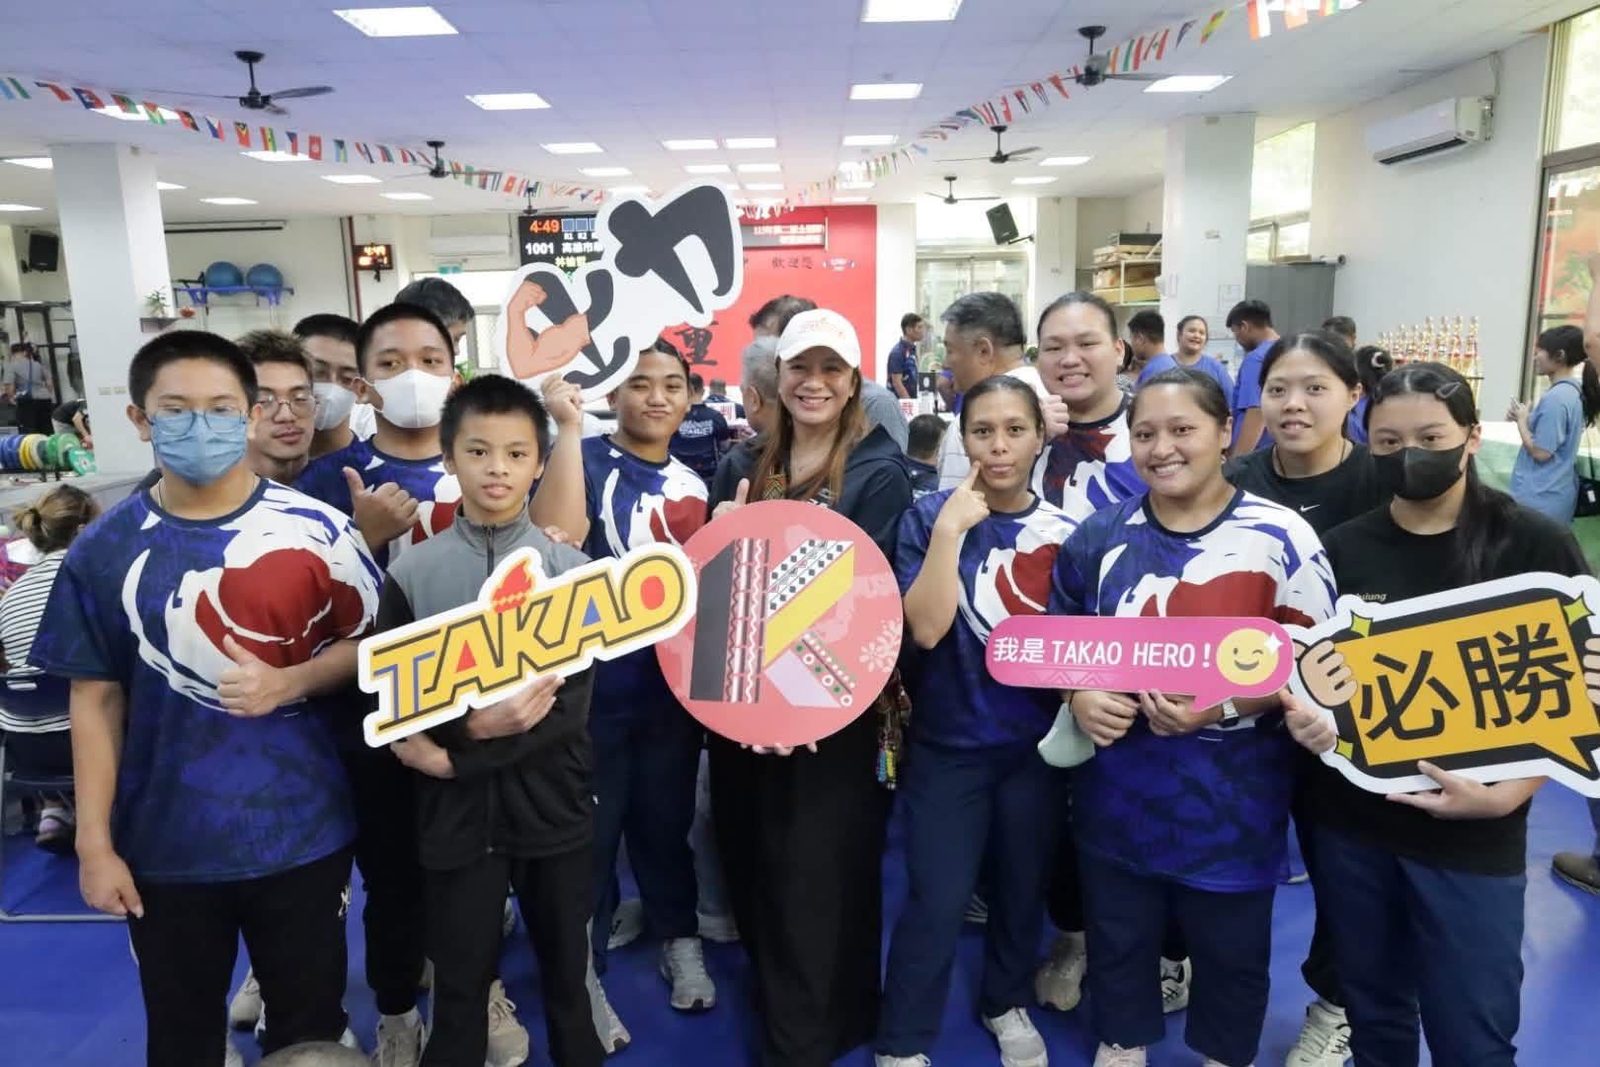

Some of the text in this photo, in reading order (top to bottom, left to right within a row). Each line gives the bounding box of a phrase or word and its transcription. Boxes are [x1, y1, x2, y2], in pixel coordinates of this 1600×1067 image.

[530, 219, 560, 233] 4:49
[525, 242, 554, 255] 1001
[371, 554, 686, 733] TAKAO
[993, 637, 1044, 664] 我是
[1051, 640, 1122, 665] TAKAO
[1360, 623, 1575, 741] 必勝
